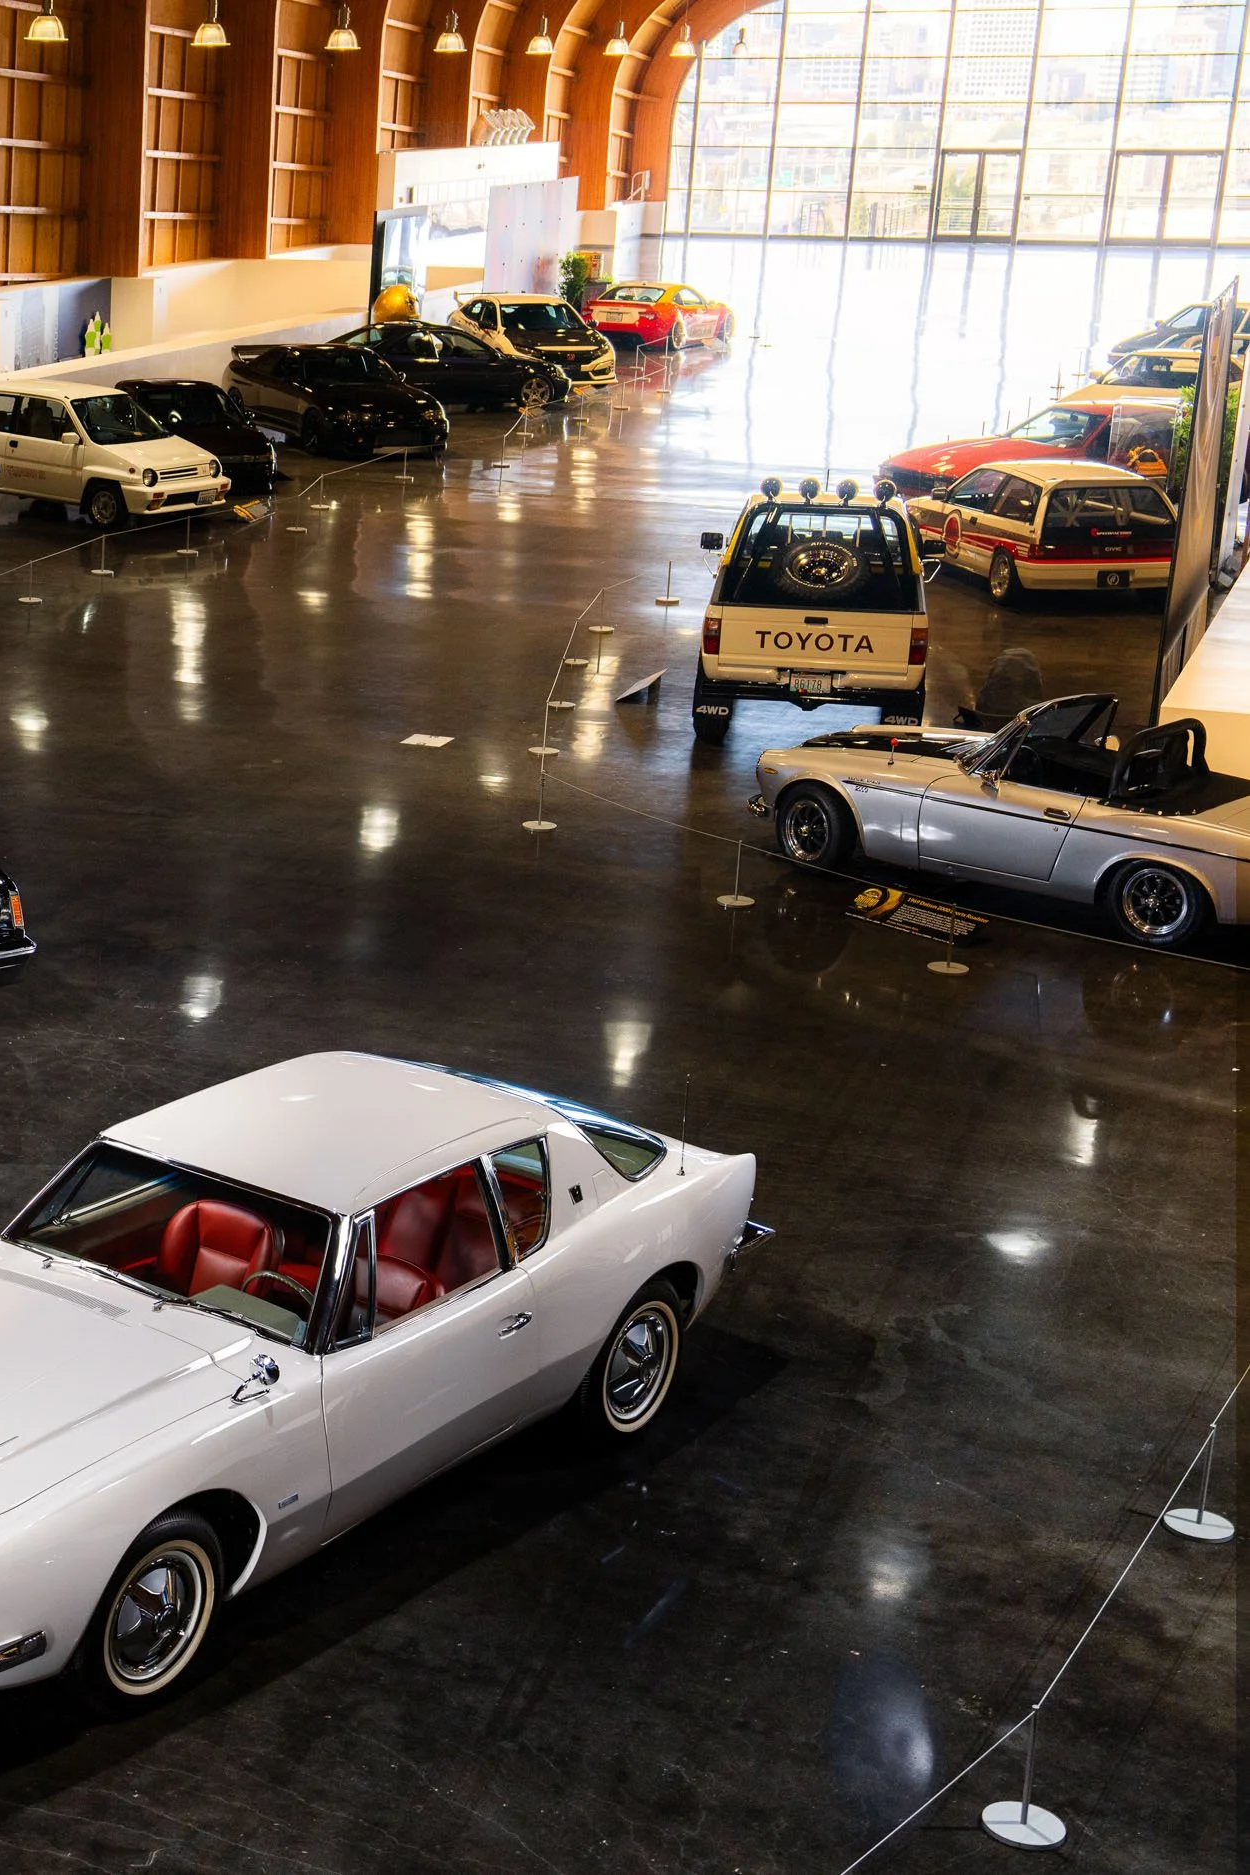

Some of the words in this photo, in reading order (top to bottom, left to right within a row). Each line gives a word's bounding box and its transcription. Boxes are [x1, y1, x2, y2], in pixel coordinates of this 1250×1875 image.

[755, 630, 874, 654] TOYOTA
[696, 705, 729, 715] 4WD
[885, 715, 918, 725] 4WD
